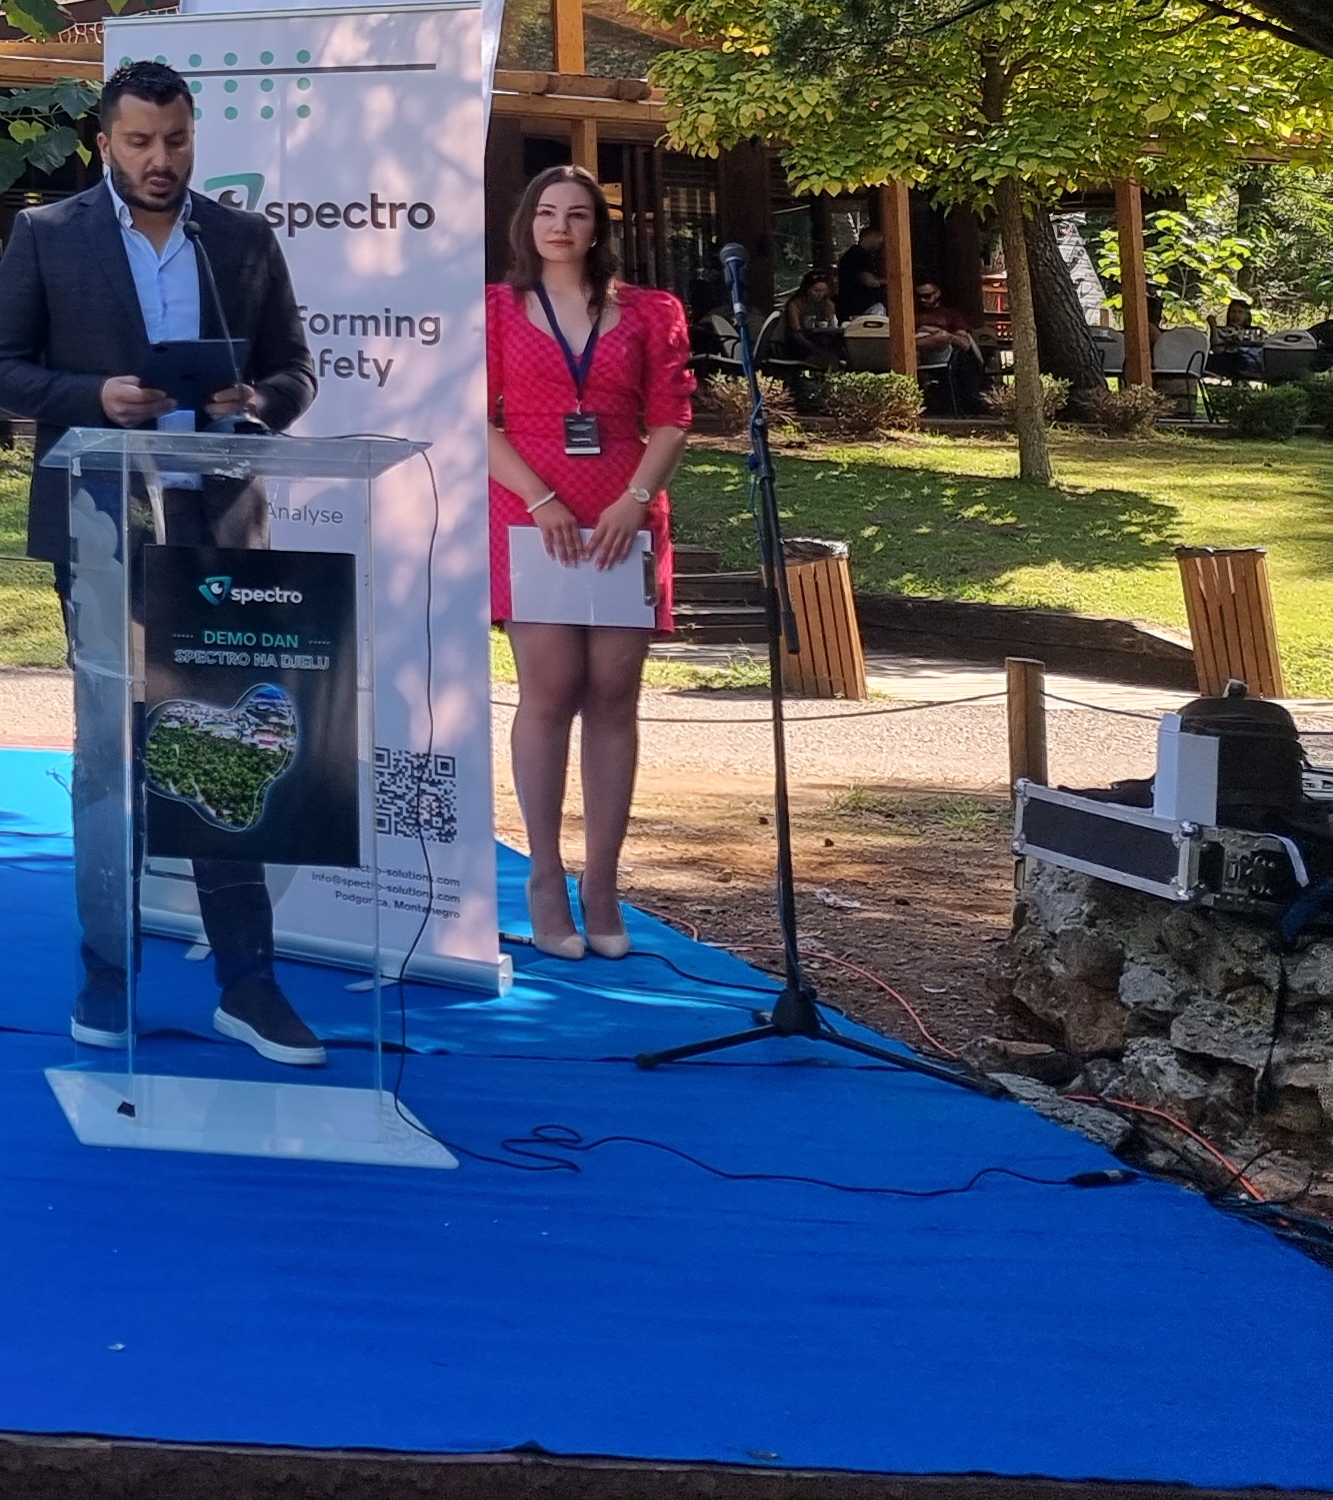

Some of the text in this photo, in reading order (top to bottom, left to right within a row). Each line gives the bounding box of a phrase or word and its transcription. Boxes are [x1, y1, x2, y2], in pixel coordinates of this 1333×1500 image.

[264, 192, 436, 238] spectro
[313, 348, 395, 388] fety
[265, 501, 344, 527] Analyse
[230, 586, 304, 605] spectro
[203, 630, 300, 649] DEMO DAN
[173, 649, 330, 671] SPECTRO NA DJELU
[335, 889, 392, 910] Podgorca,
